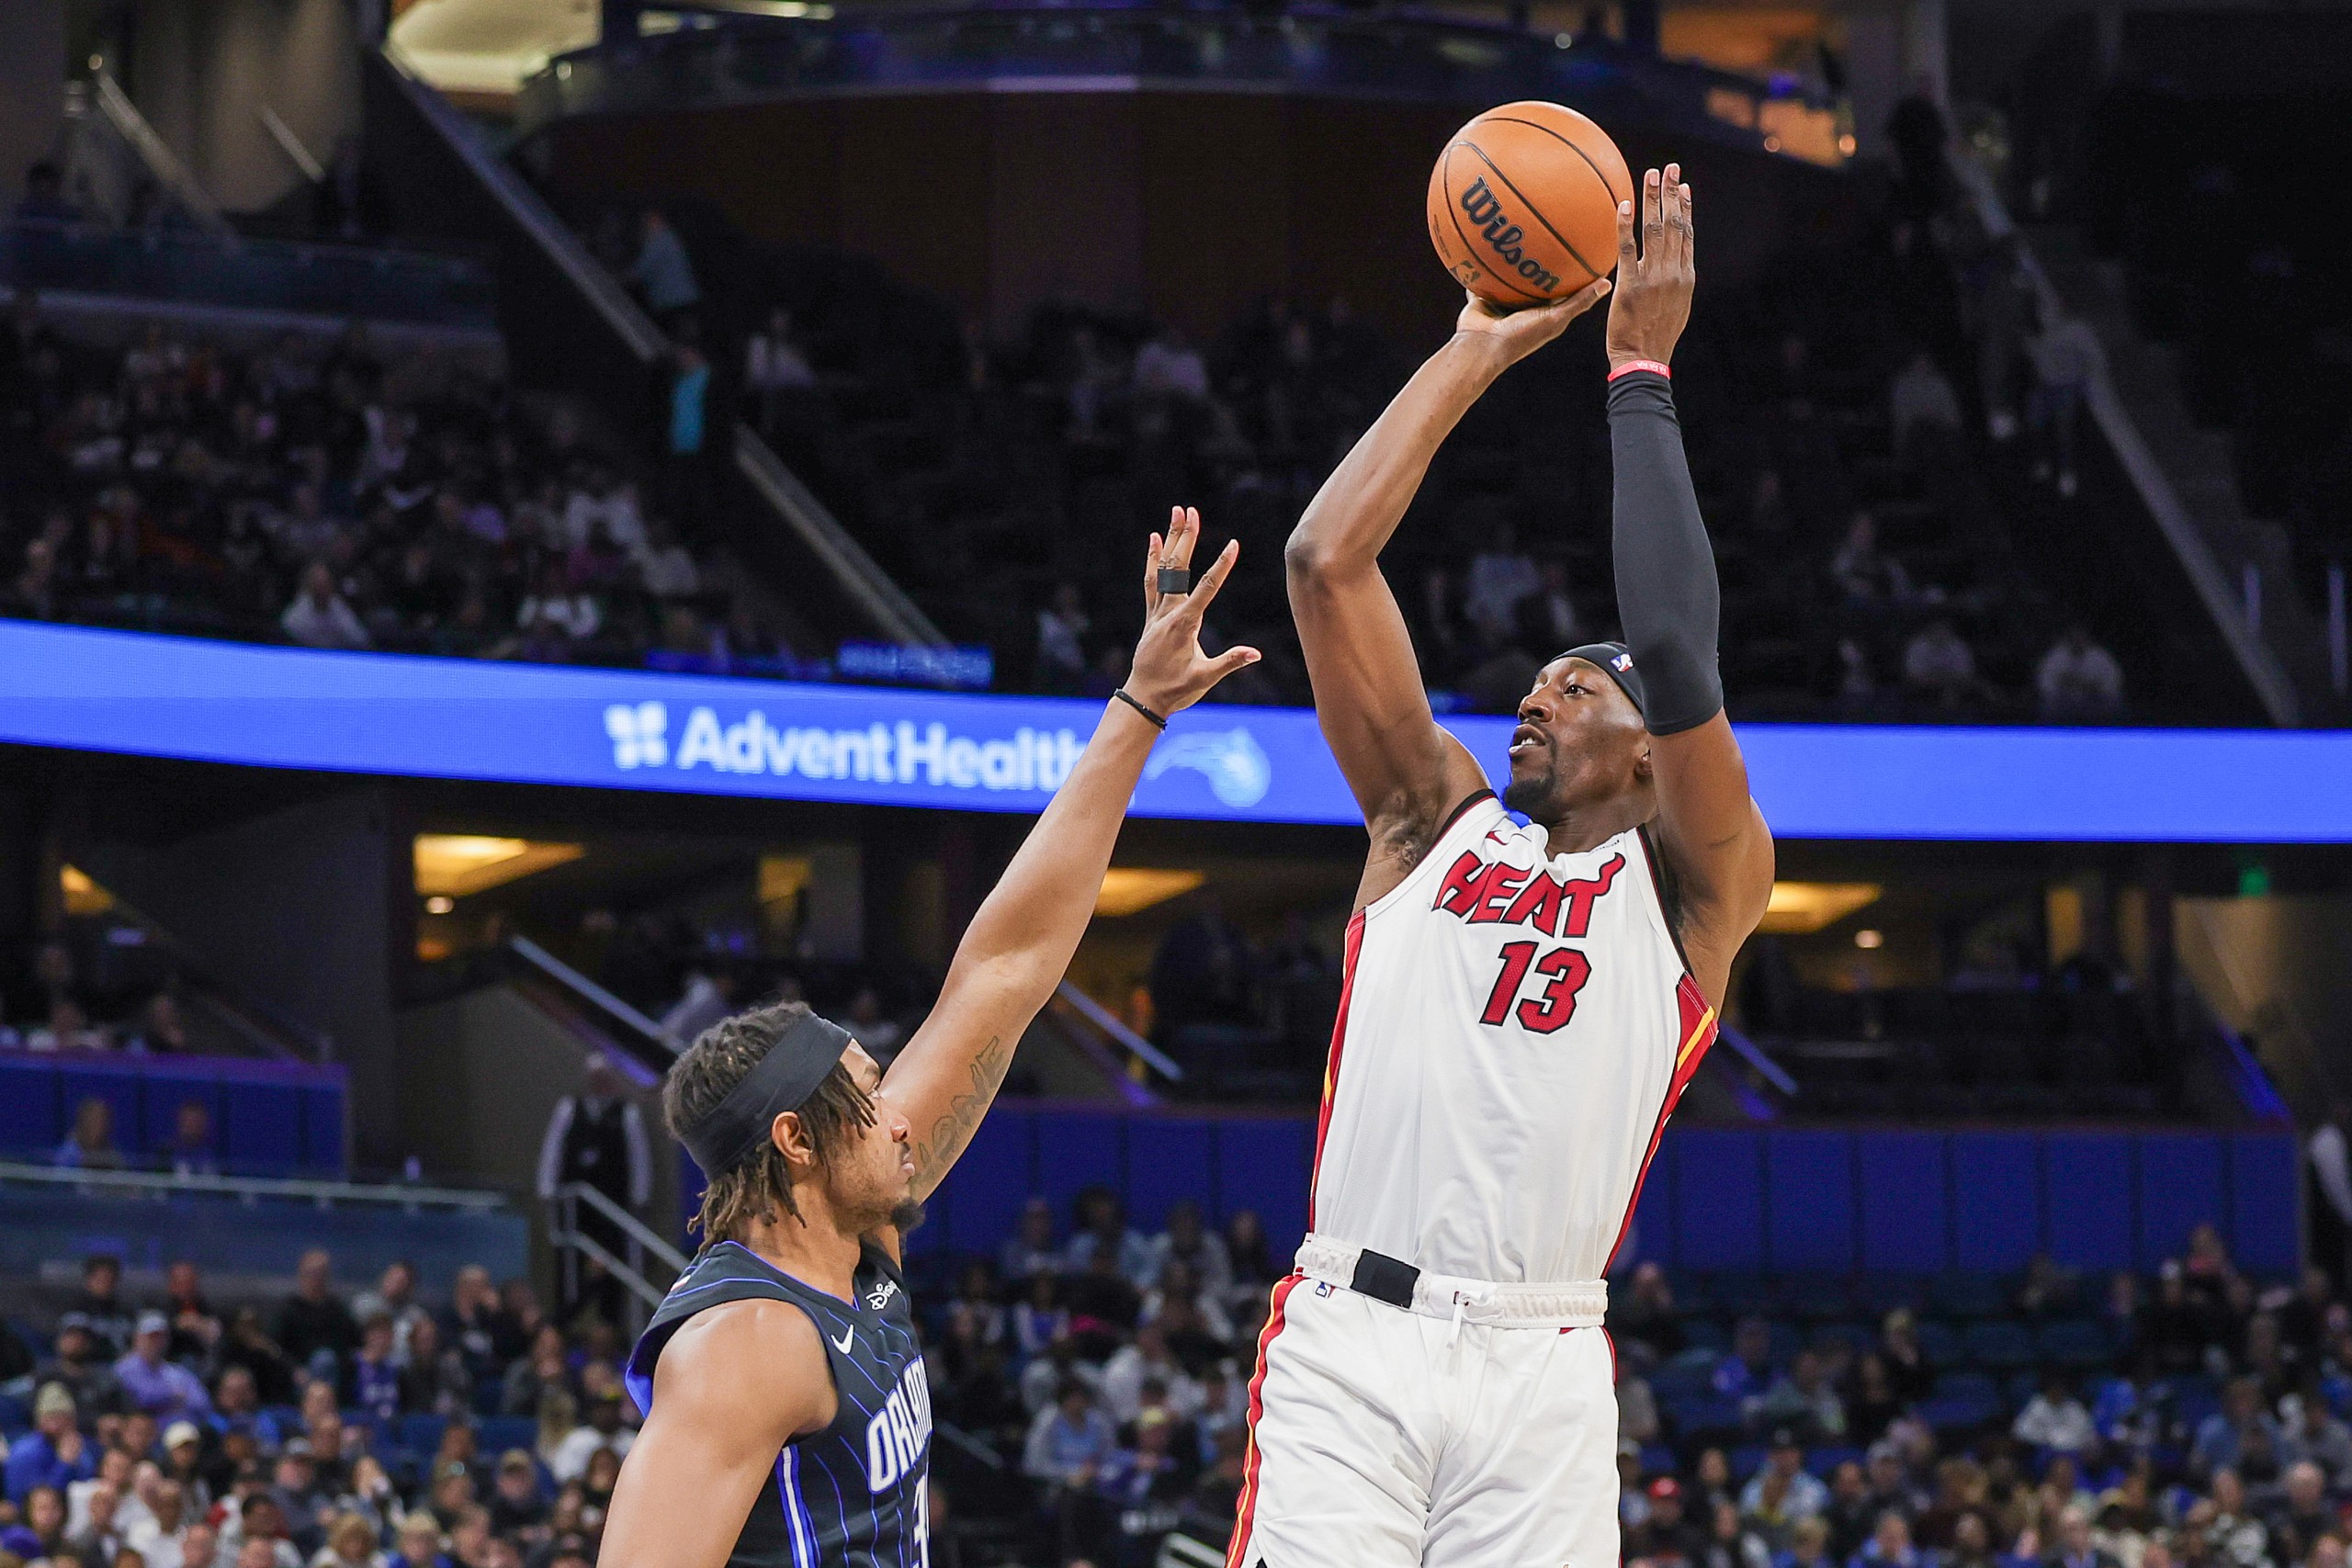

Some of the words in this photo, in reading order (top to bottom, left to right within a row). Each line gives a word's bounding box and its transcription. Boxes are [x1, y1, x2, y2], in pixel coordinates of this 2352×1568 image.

[1461, 175, 1561, 293] Wilson
[1431, 850, 1626, 939] HEAT
[1479, 940, 1592, 1035] 13
[865, 1279, 902, 1311] Disy
